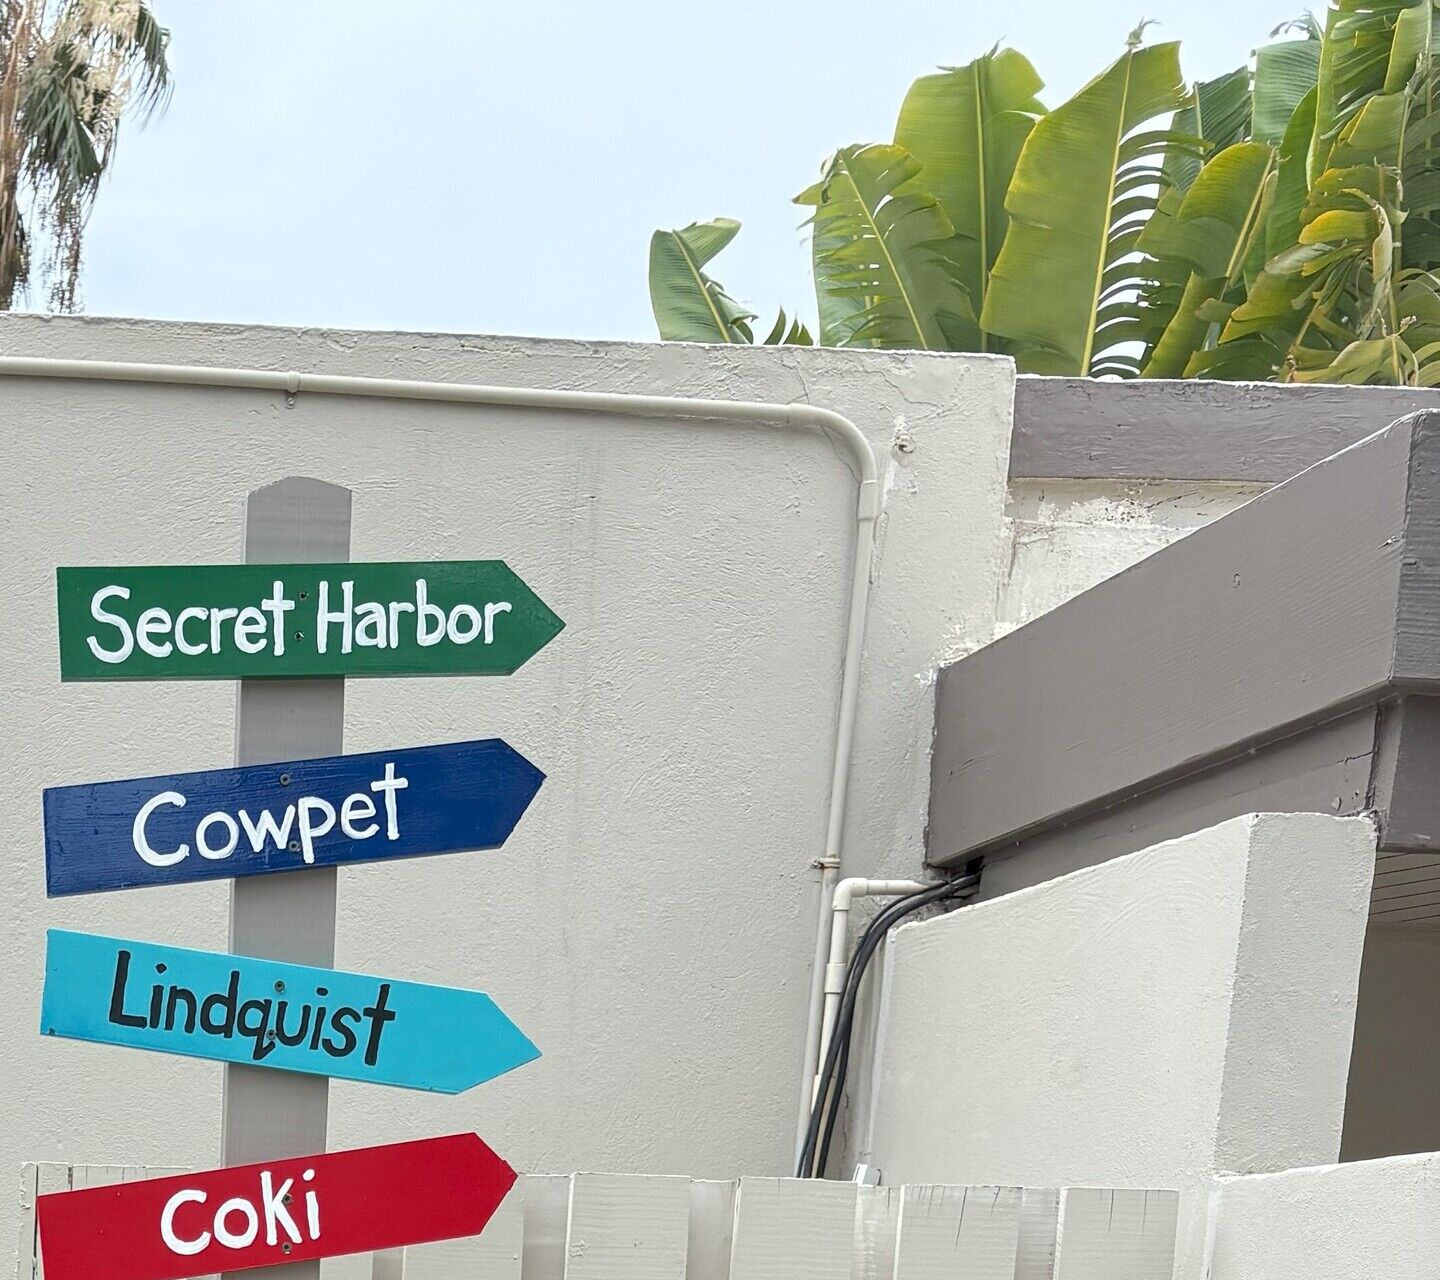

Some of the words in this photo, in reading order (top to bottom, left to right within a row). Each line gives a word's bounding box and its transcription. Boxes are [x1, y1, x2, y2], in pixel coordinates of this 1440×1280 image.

[86, 580, 295, 663] Secret
[316, 578, 512, 655] Harbor
[132, 762, 408, 864] Cowpet
[108, 950, 397, 1067] Lindquist
[160, 1168, 321, 1256] Coki
